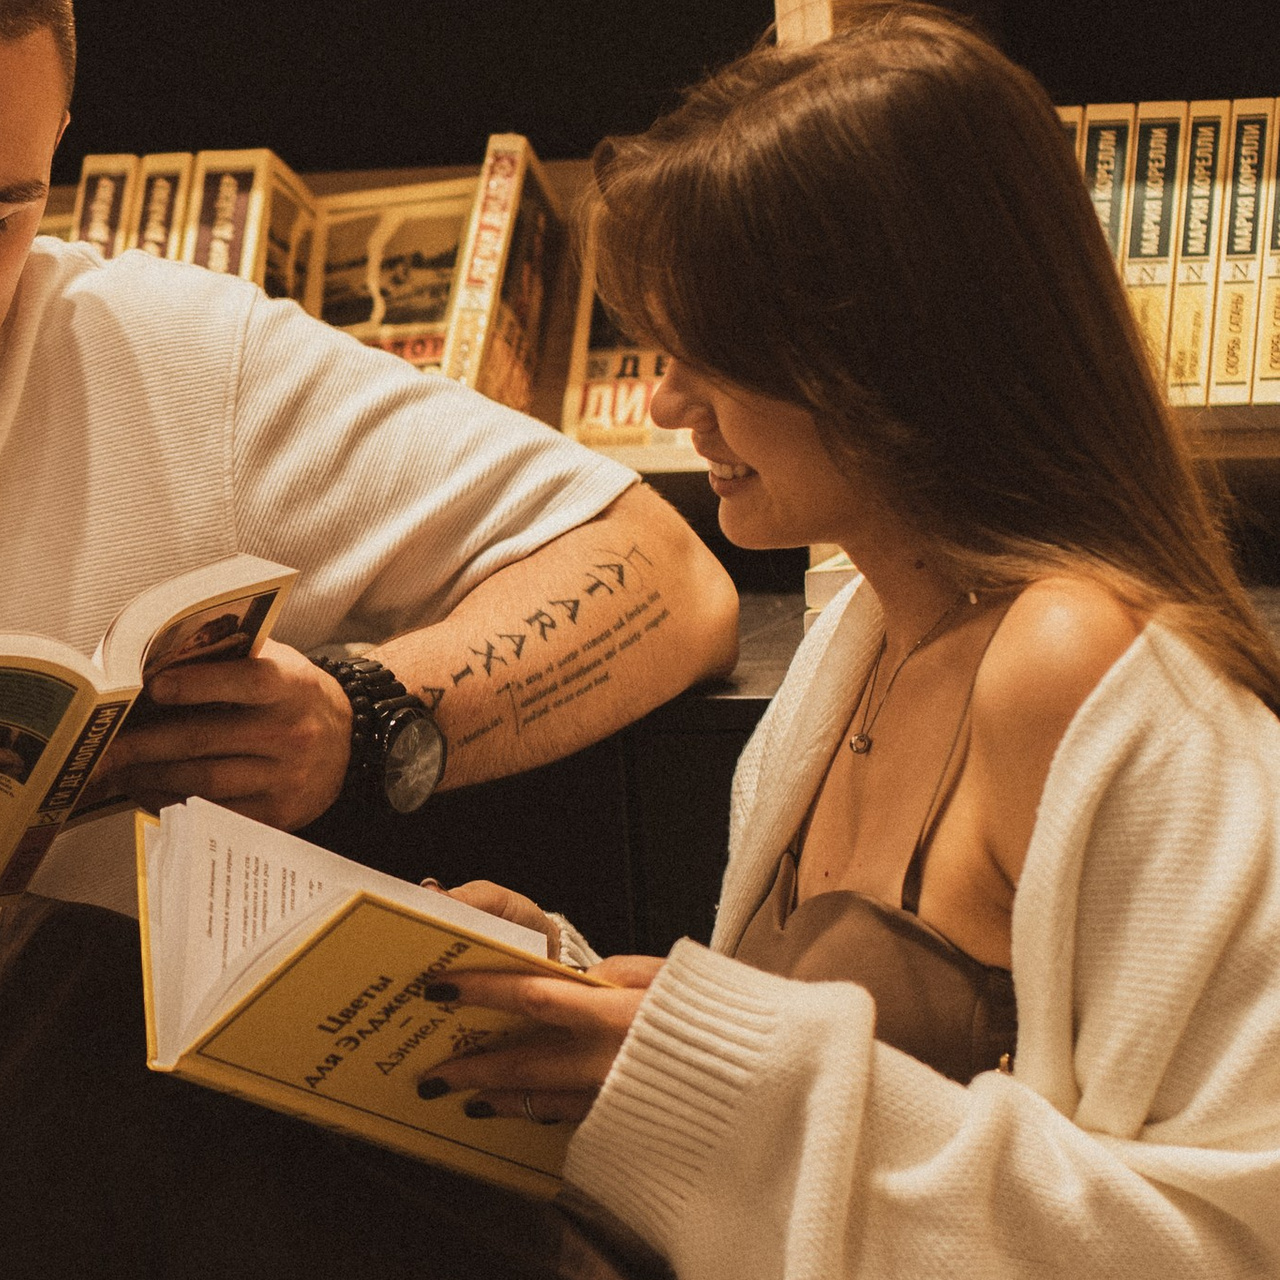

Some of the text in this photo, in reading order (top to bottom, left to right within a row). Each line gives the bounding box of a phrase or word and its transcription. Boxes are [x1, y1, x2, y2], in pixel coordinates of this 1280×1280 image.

[1141, 127, 1168, 255] МАРИЯ КОРЕЛЛИ
[1188, 126, 1215, 255] МАРИЯ КОРЕЛЛИ
[1235, 124, 1261, 252] МАРИЯ КОРЕЛЛИ
[69, 707, 120, 771] МОПАССАН
[59, 772, 83, 788] ДЕ
[208, 838, 217, 852] 115
[317, 975, 394, 1034] Цветы
[305, 1052, 344, 1089] для
[375, 1017, 446, 1076] Дэниел
